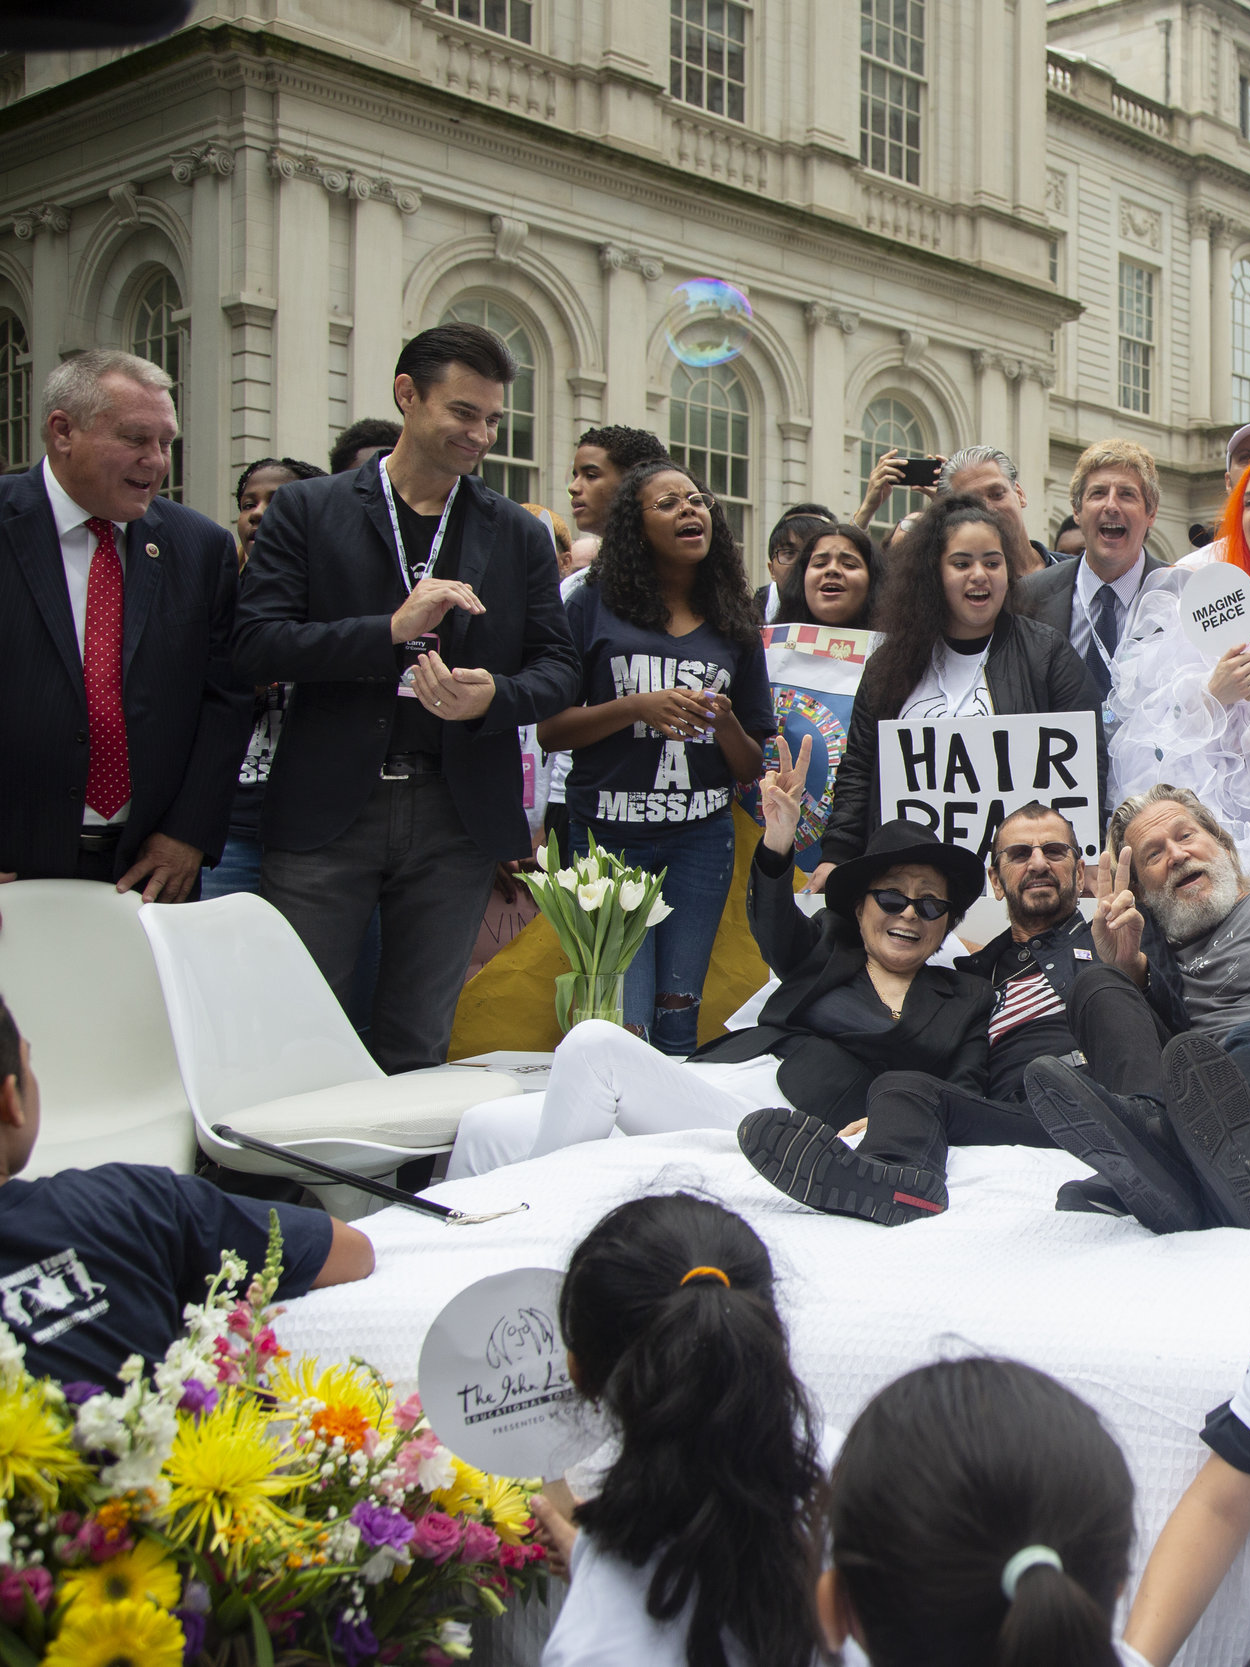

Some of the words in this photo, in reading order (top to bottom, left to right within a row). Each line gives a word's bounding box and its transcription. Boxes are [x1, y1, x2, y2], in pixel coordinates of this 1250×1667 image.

[1192, 589, 1246, 622] IMAGINE
[1202, 604, 1245, 632] PEACE
[654, 740, 691, 790] A
[897, 726, 1078, 793] HAIR
[897, 797, 1097, 864] PEA.
[457, 1384, 496, 1413] The
[496, 1373, 539, 1409] John
[544, 1361, 570, 1390] Le
[492, 1415, 545, 1434] PRESENTED
